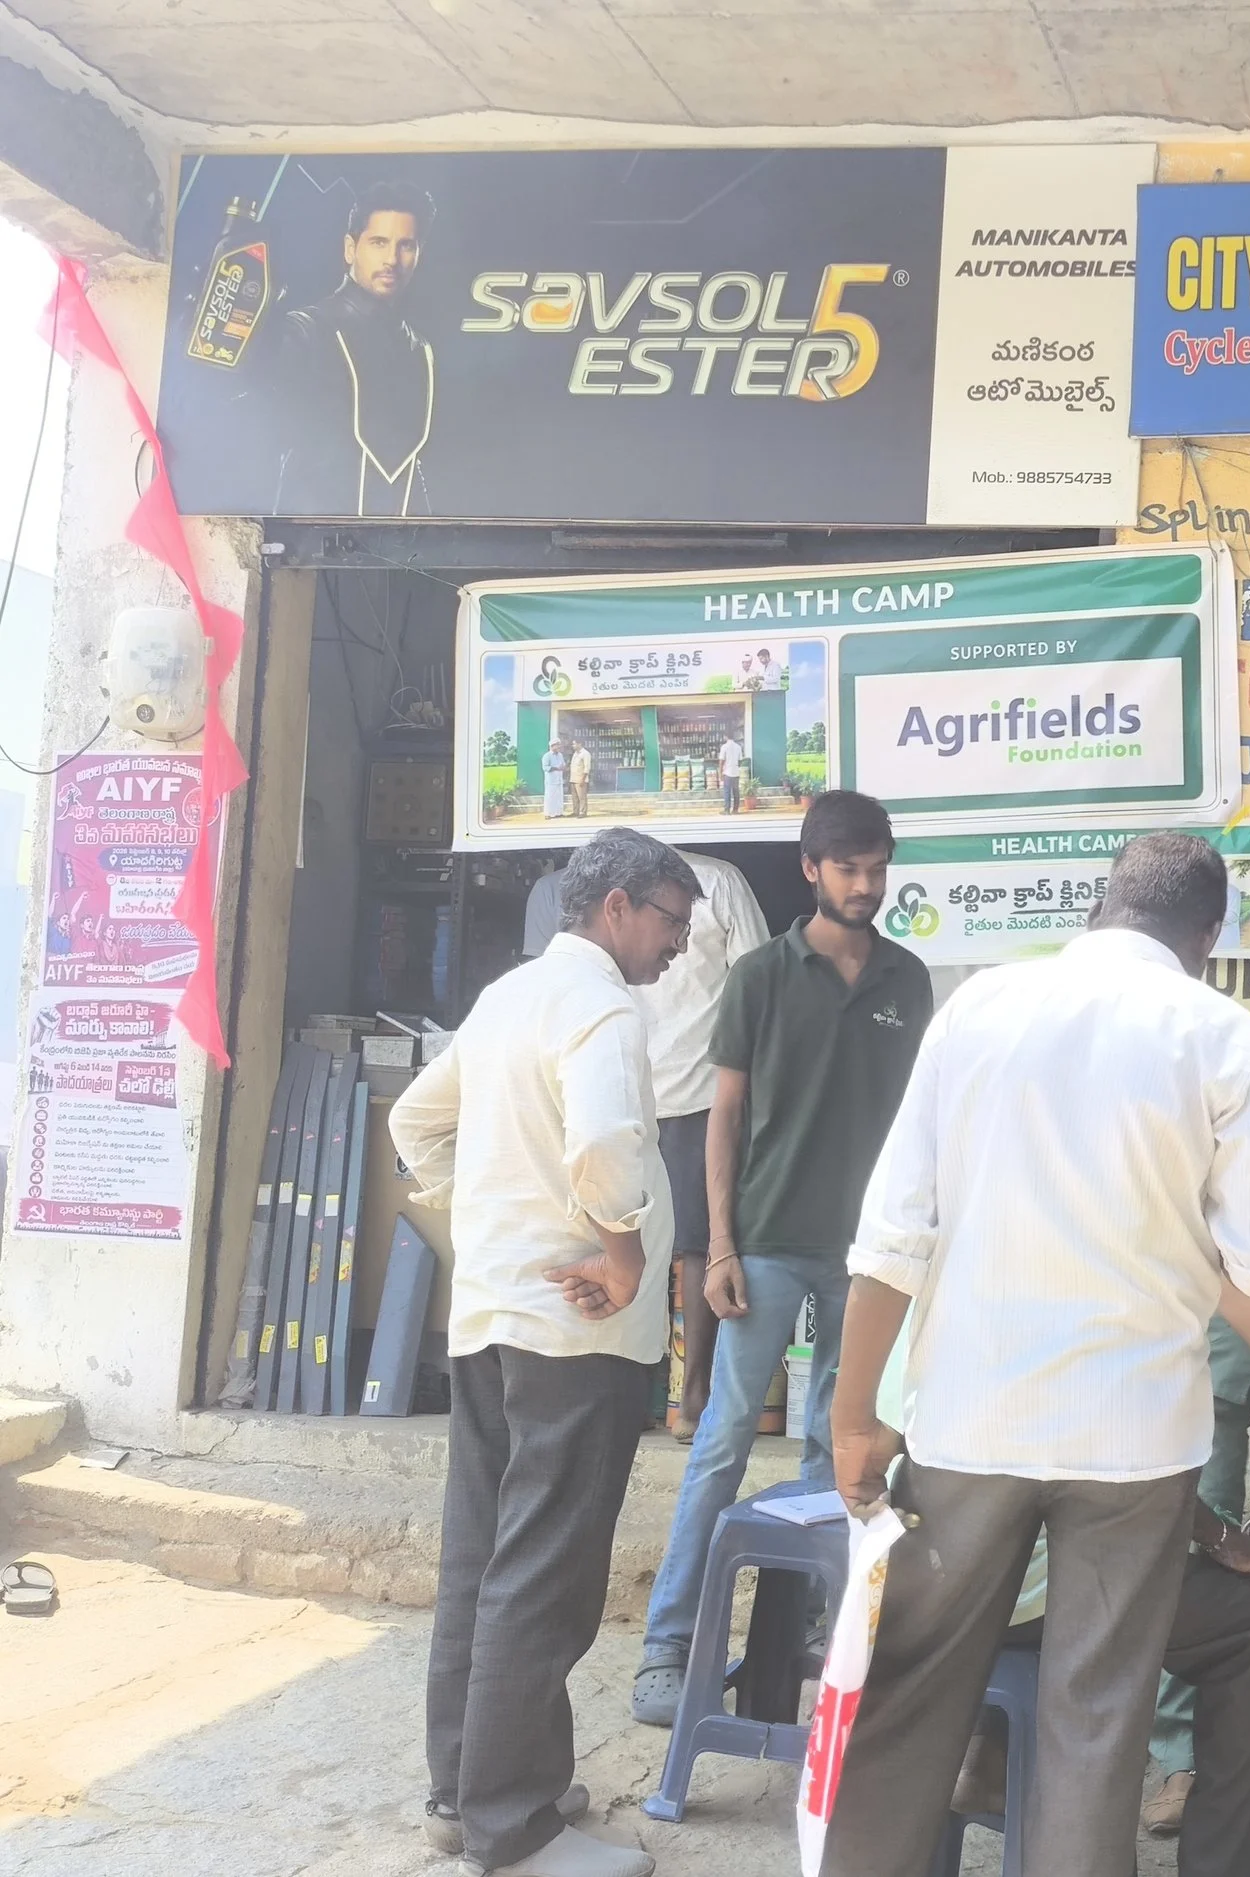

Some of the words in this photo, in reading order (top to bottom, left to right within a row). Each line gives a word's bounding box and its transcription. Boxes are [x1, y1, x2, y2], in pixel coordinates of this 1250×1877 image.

[971, 229, 1128, 246] MANIKANTA
[955, 260, 1136, 277] AUTOMOBILES
[991, 337, 1095, 362] మణికంఠ
[568, 337, 858, 399] ESTER
[1016, 472, 1112, 485] 9885754733
[703, 589, 840, 621] HEALTH
[851, 582, 955, 615] CAMP
[950, 641, 1049, 661] SUPPORTED
[1055, 639, 1078, 655] BY
[897, 693, 1143, 757] Agrifields
[1008, 741, 1143, 764] Foundation
[96, 777, 182, 801] AIYF
[991, 835, 1072, 856] HEALTH
[948, 884, 1007, 913] కల్టివా
[1013, 878, 1053, 908] క్రాప్
[1055, 914, 1087, 928] ఎంపి
[45, 964, 84, 981] AIYF
[60, 1206, 90, 1216] భారత
